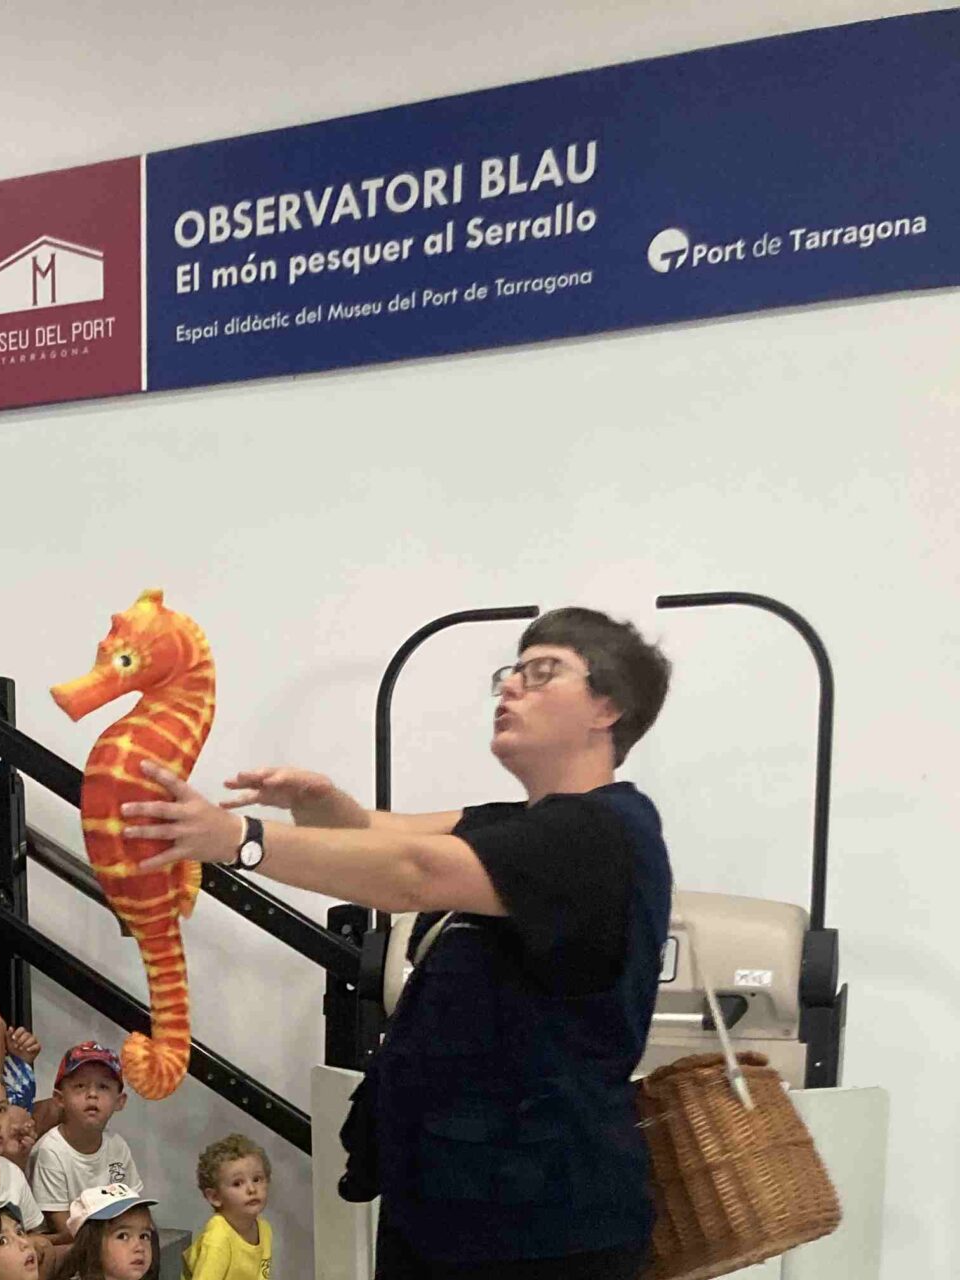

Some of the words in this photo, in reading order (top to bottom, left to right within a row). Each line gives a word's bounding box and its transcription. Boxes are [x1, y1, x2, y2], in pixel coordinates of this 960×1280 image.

[174, 163, 464, 248] OBSERVATORI
[480, 140, 598, 199] BLAU
[176, 261, 201, 294] El
[212, 252, 278, 289] món
[289, 237, 414, 285] pesquer
[423, 221, 455, 256] al
[466, 201, 598, 249] Serrallo
[692, 239, 746, 267] Port
[752, 233, 782, 258] de
[789, 215, 927, 252] Tarragona
[35, 324, 67, 347] DEL
[71, 316, 116, 343] PORT
[176, 324, 219, 344] Espai
[224, 314, 290, 335] didàctic
[295, 305, 322, 325] del
[327, 302, 382, 321] Museu
[388, 291, 416, 312] del
[422, 288, 458, 307] Port
[463, 282, 488, 301] de
[495, 271, 592, 296] Tarragona
[0, 346, 89, 365] TARRAGONA
